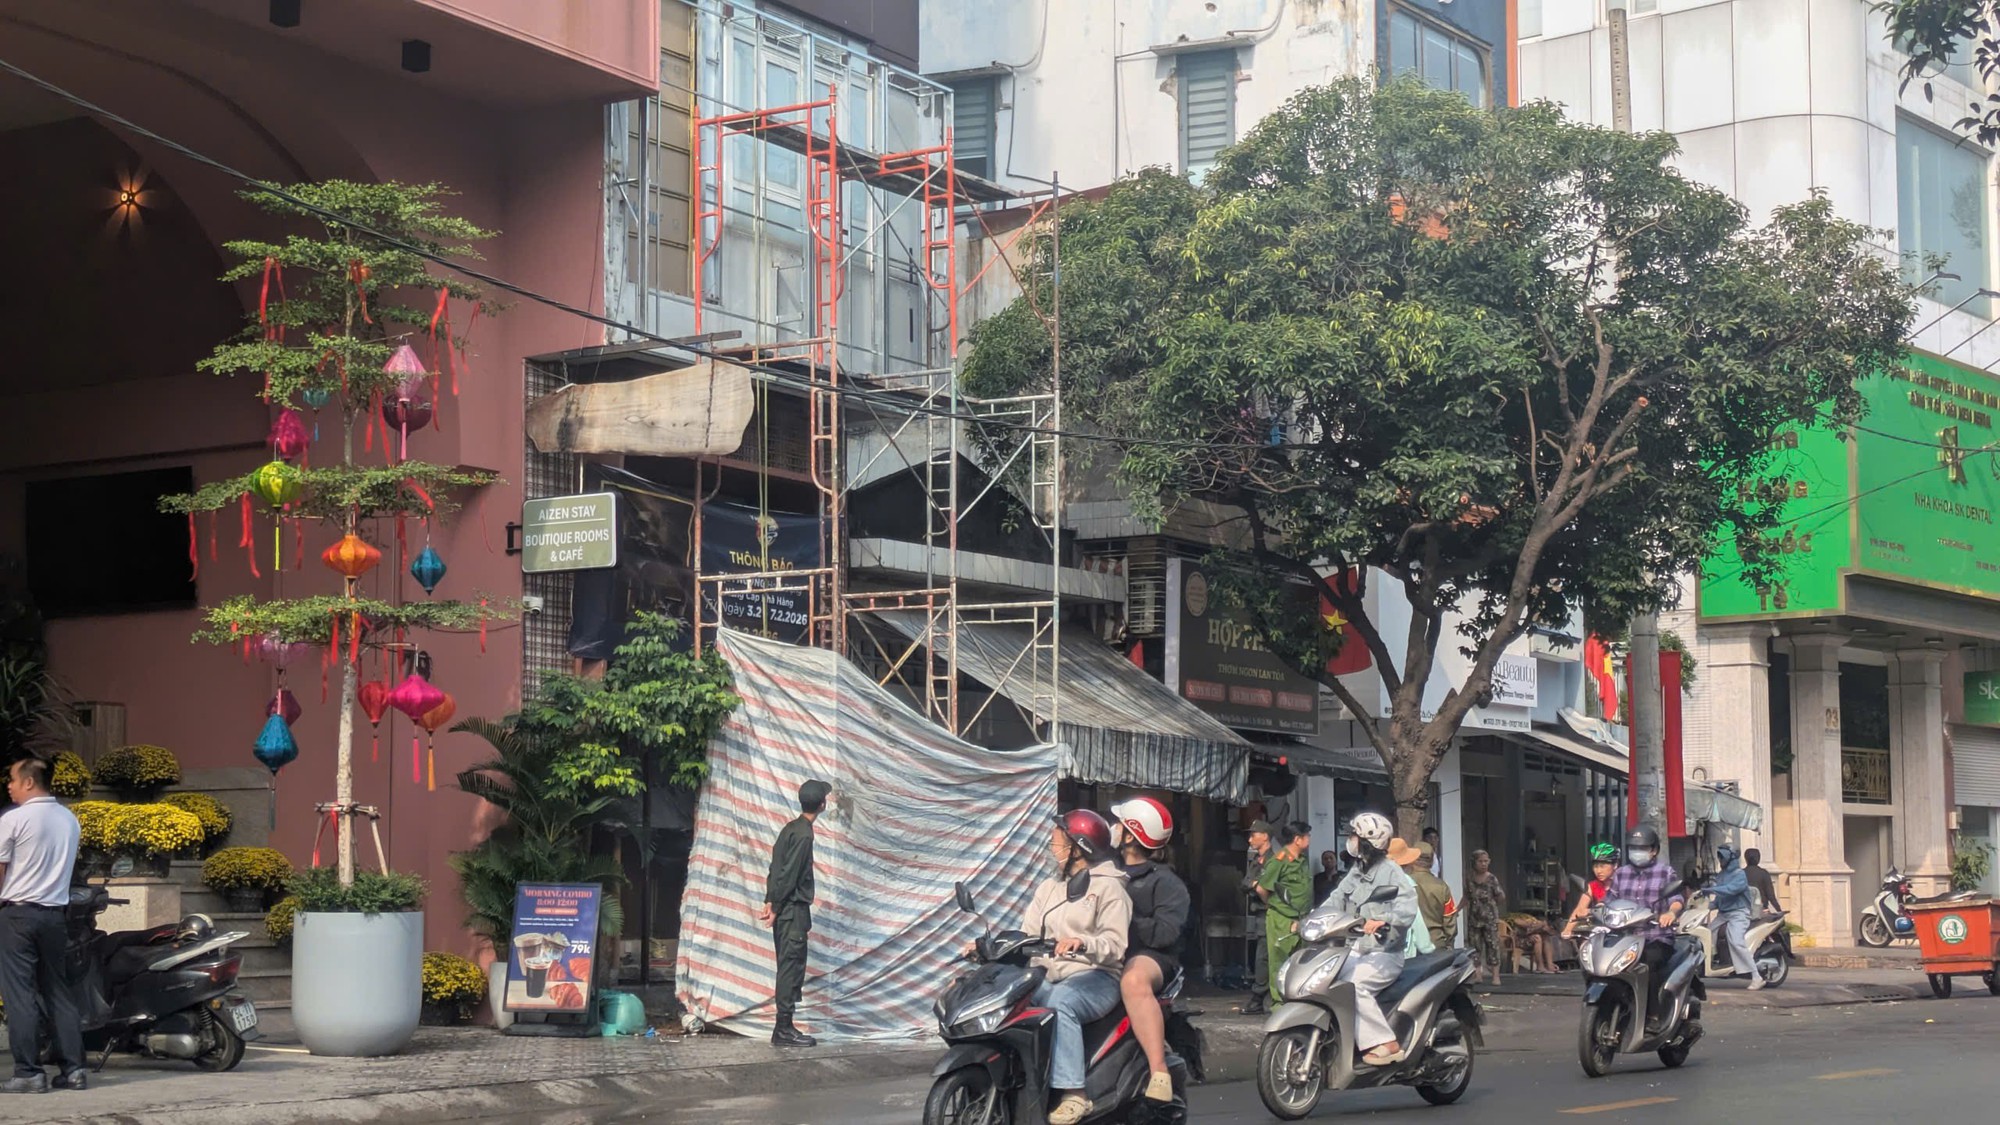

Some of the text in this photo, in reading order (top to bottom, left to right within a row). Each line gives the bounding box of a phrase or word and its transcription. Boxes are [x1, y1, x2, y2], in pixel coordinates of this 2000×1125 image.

[539, 505, 596, 520] AIZEN STAY
[1914, 492, 1993, 525] NHA KHOA SK DENTAL
[525, 529, 609, 547] BOUTIQUE ROOMS
[550, 546, 583, 562] & CAFÉ
[729, 550, 769, 568] THÔN
[747, 604, 762, 618] 3.2
[769, 608, 808, 626] 7.2.2026
[1503, 660, 1536, 689] Beauty
[570, 944, 591, 954] 79k
